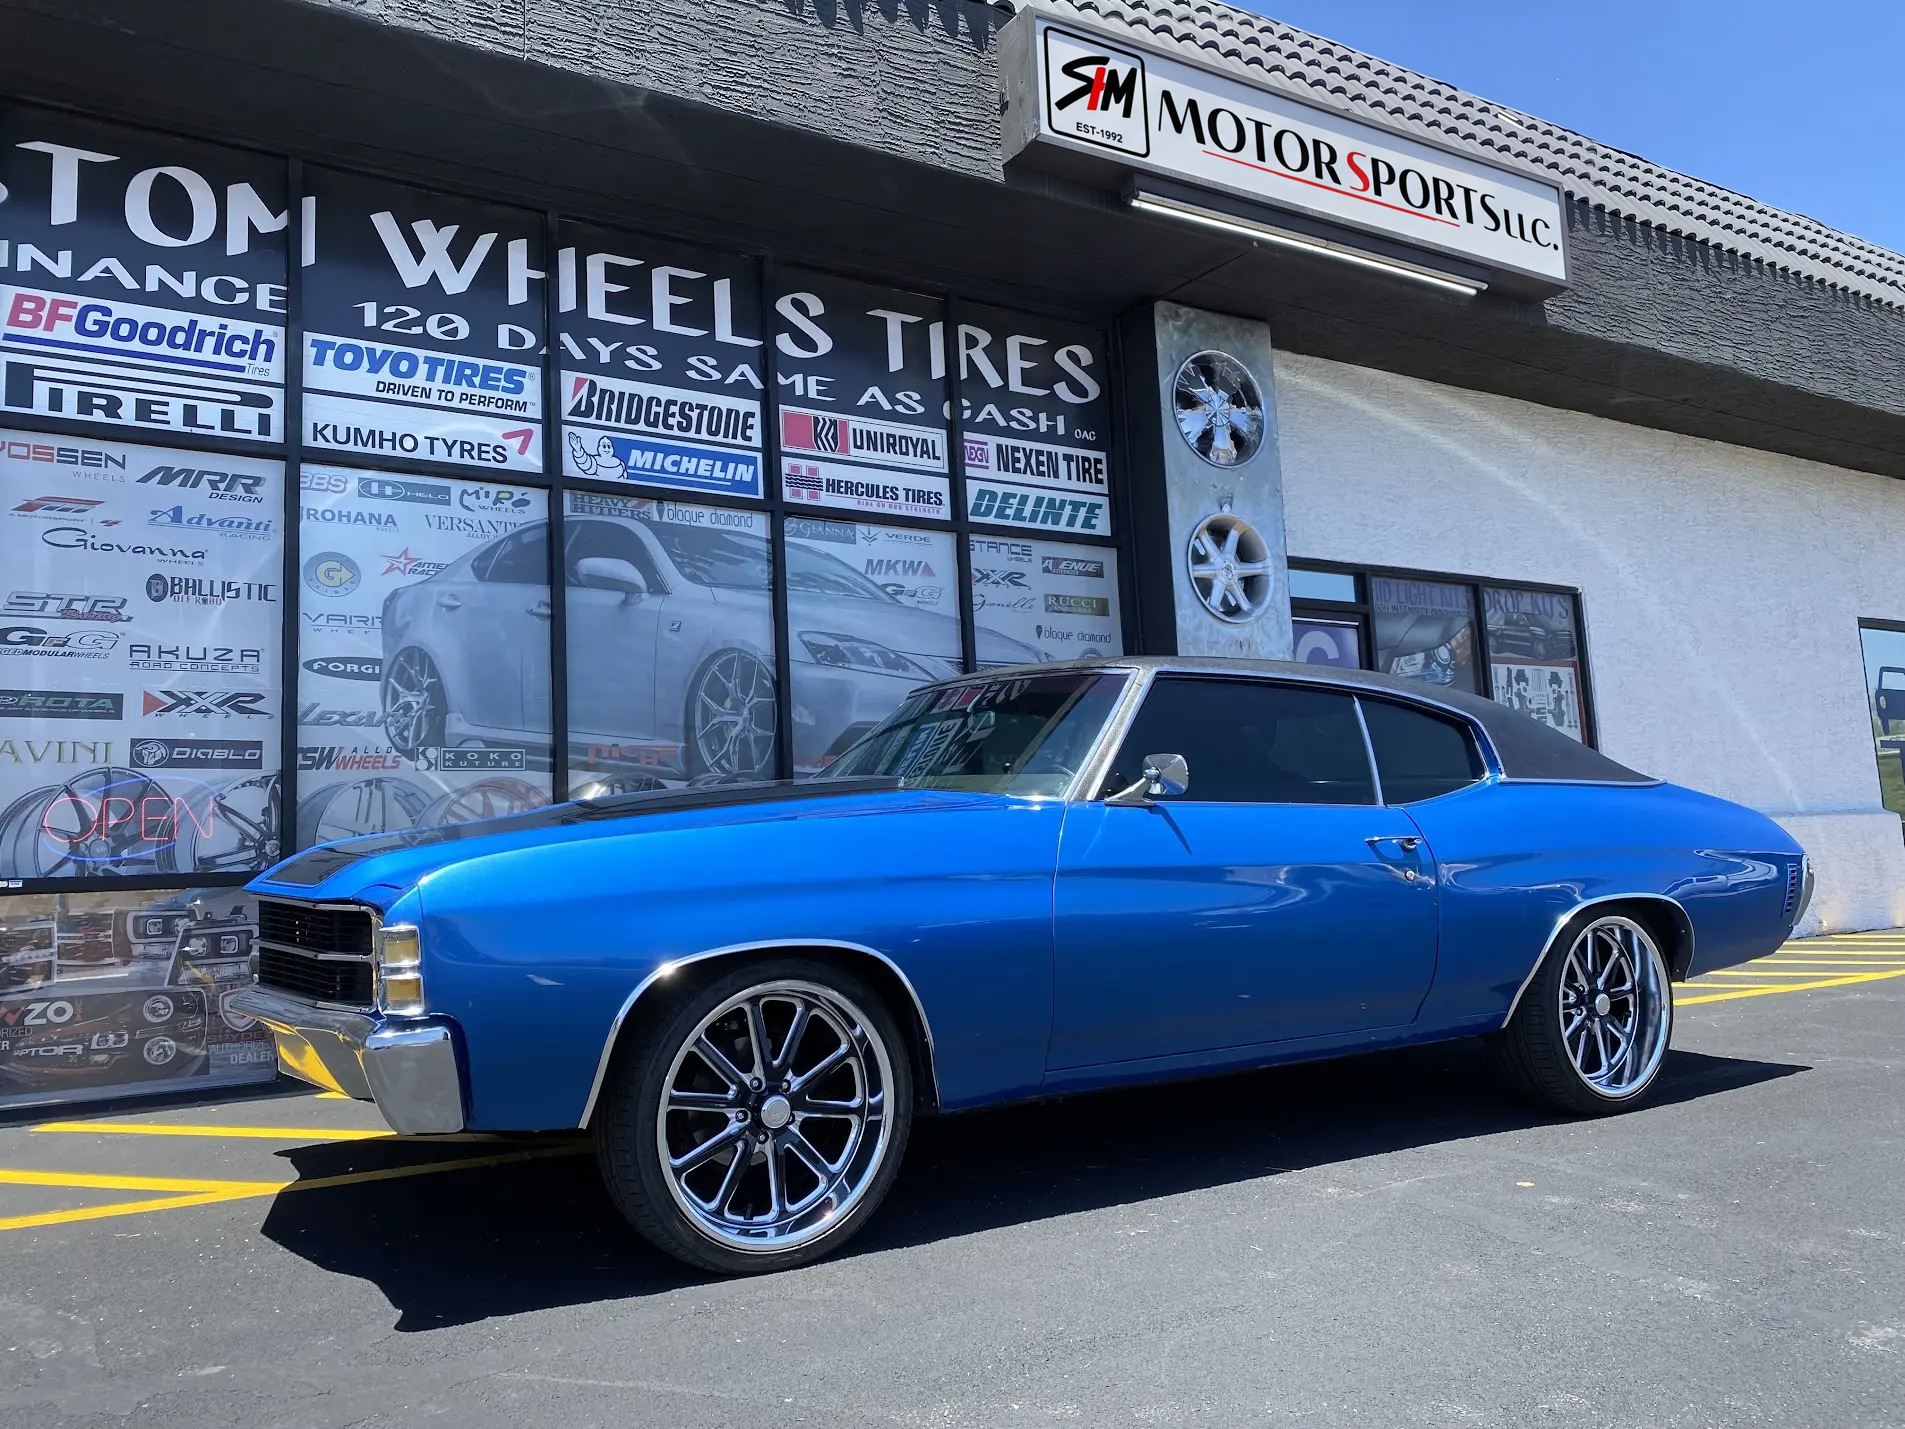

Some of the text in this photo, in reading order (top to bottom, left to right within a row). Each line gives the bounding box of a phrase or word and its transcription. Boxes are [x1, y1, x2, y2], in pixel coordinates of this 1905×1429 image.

[1076, 121, 1123, 144] EST-1992
[0, 141, 1101, 403] TOM WHEELS TIRES
[6, 292, 276, 362] BFGoodrich
[246, 361, 271, 378] Tires
[311, 339, 527, 395] TOYO TIRES
[353, 301, 470, 341] 120
[498, 323, 663, 372] DAYS
[686, 355, 836, 401] SAME
[856, 385, 926, 415] AS
[943, 398, 1066, 436] CASH
[4, 360, 274, 437] PIRELLI
[375, 380, 430, 401] DRIVEN
[435, 387, 456, 403] TO
[568, 376, 755, 441] BRIDGESTONE
[312, 421, 508, 465] KUMHO TYRES
[852, 427, 942, 461] UNIROYAL
[0, 441, 126, 470] OSSEN
[628, 448, 755, 483] MICHELIN
[996, 443, 1104, 486] NEXEN TIRE
[73, 470, 126, 483] WHEELS
[136, 465, 267, 496] MRR
[208, 492, 263, 504] DESIGN
[406, 491, 450, 500] HELO
[825, 476, 943, 507] HERCULES TIRES
[306, 508, 398, 527] ROHANA
[478, 504, 526, 514] WHEELS
[969, 487, 1103, 528] DELINTE
[148, 505, 273, 532] Advanti
[710, 508, 753, 528] diamond
[41, 526, 208, 559] Giovanna
[466, 531, 490, 539] ALLOY
[885, 532, 932, 543] VERDE
[969, 540, 1033, 557] STANCE
[157, 558, 204, 566] WHEELS
[864, 558, 922, 577] MKW
[170, 576, 277, 602] BALLISTIC
[1397, 581, 1436, 607] LIGHT
[1048, 596, 1097, 609] RUCCI
[1391, 604, 1429, 615] INTENSITY
[1077, 630, 1112, 644] diamond
[129, 644, 261, 663] AKUZA
[130, 660, 261, 673] ROAD CONCEPTS
[18, 693, 114, 709] ROTA
[172, 746, 261, 761] DIABLO
[335, 753, 402, 770] WHEELS
[446, 752, 522, 760] KOKO
[44, 796, 215, 843] OPEN
[0, 1026, 33, 1038] RIZED
